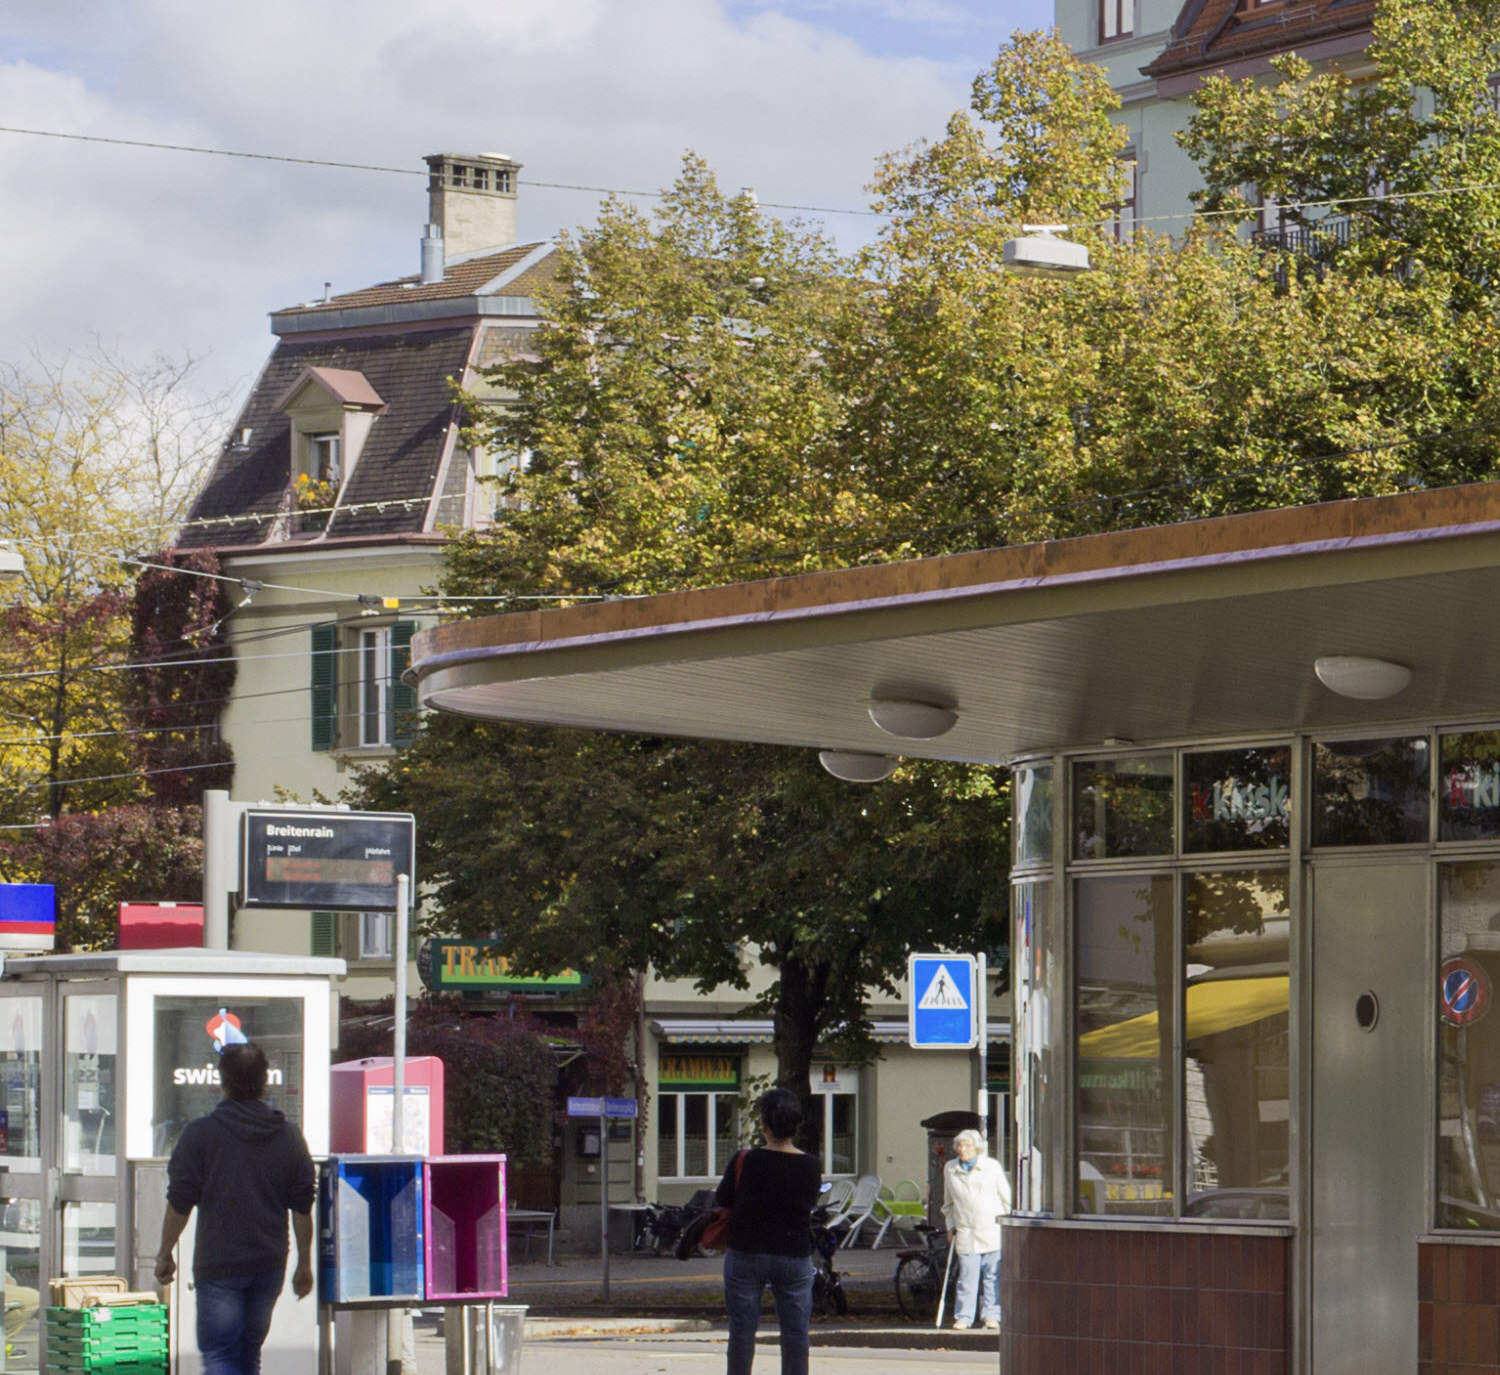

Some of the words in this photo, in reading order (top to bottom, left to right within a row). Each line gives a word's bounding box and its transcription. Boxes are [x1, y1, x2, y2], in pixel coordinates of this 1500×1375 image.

[1450, 766, 1470, 810] k
[266, 824, 334, 839] Breitenrain
[173, 1062, 283, 1086] swism
